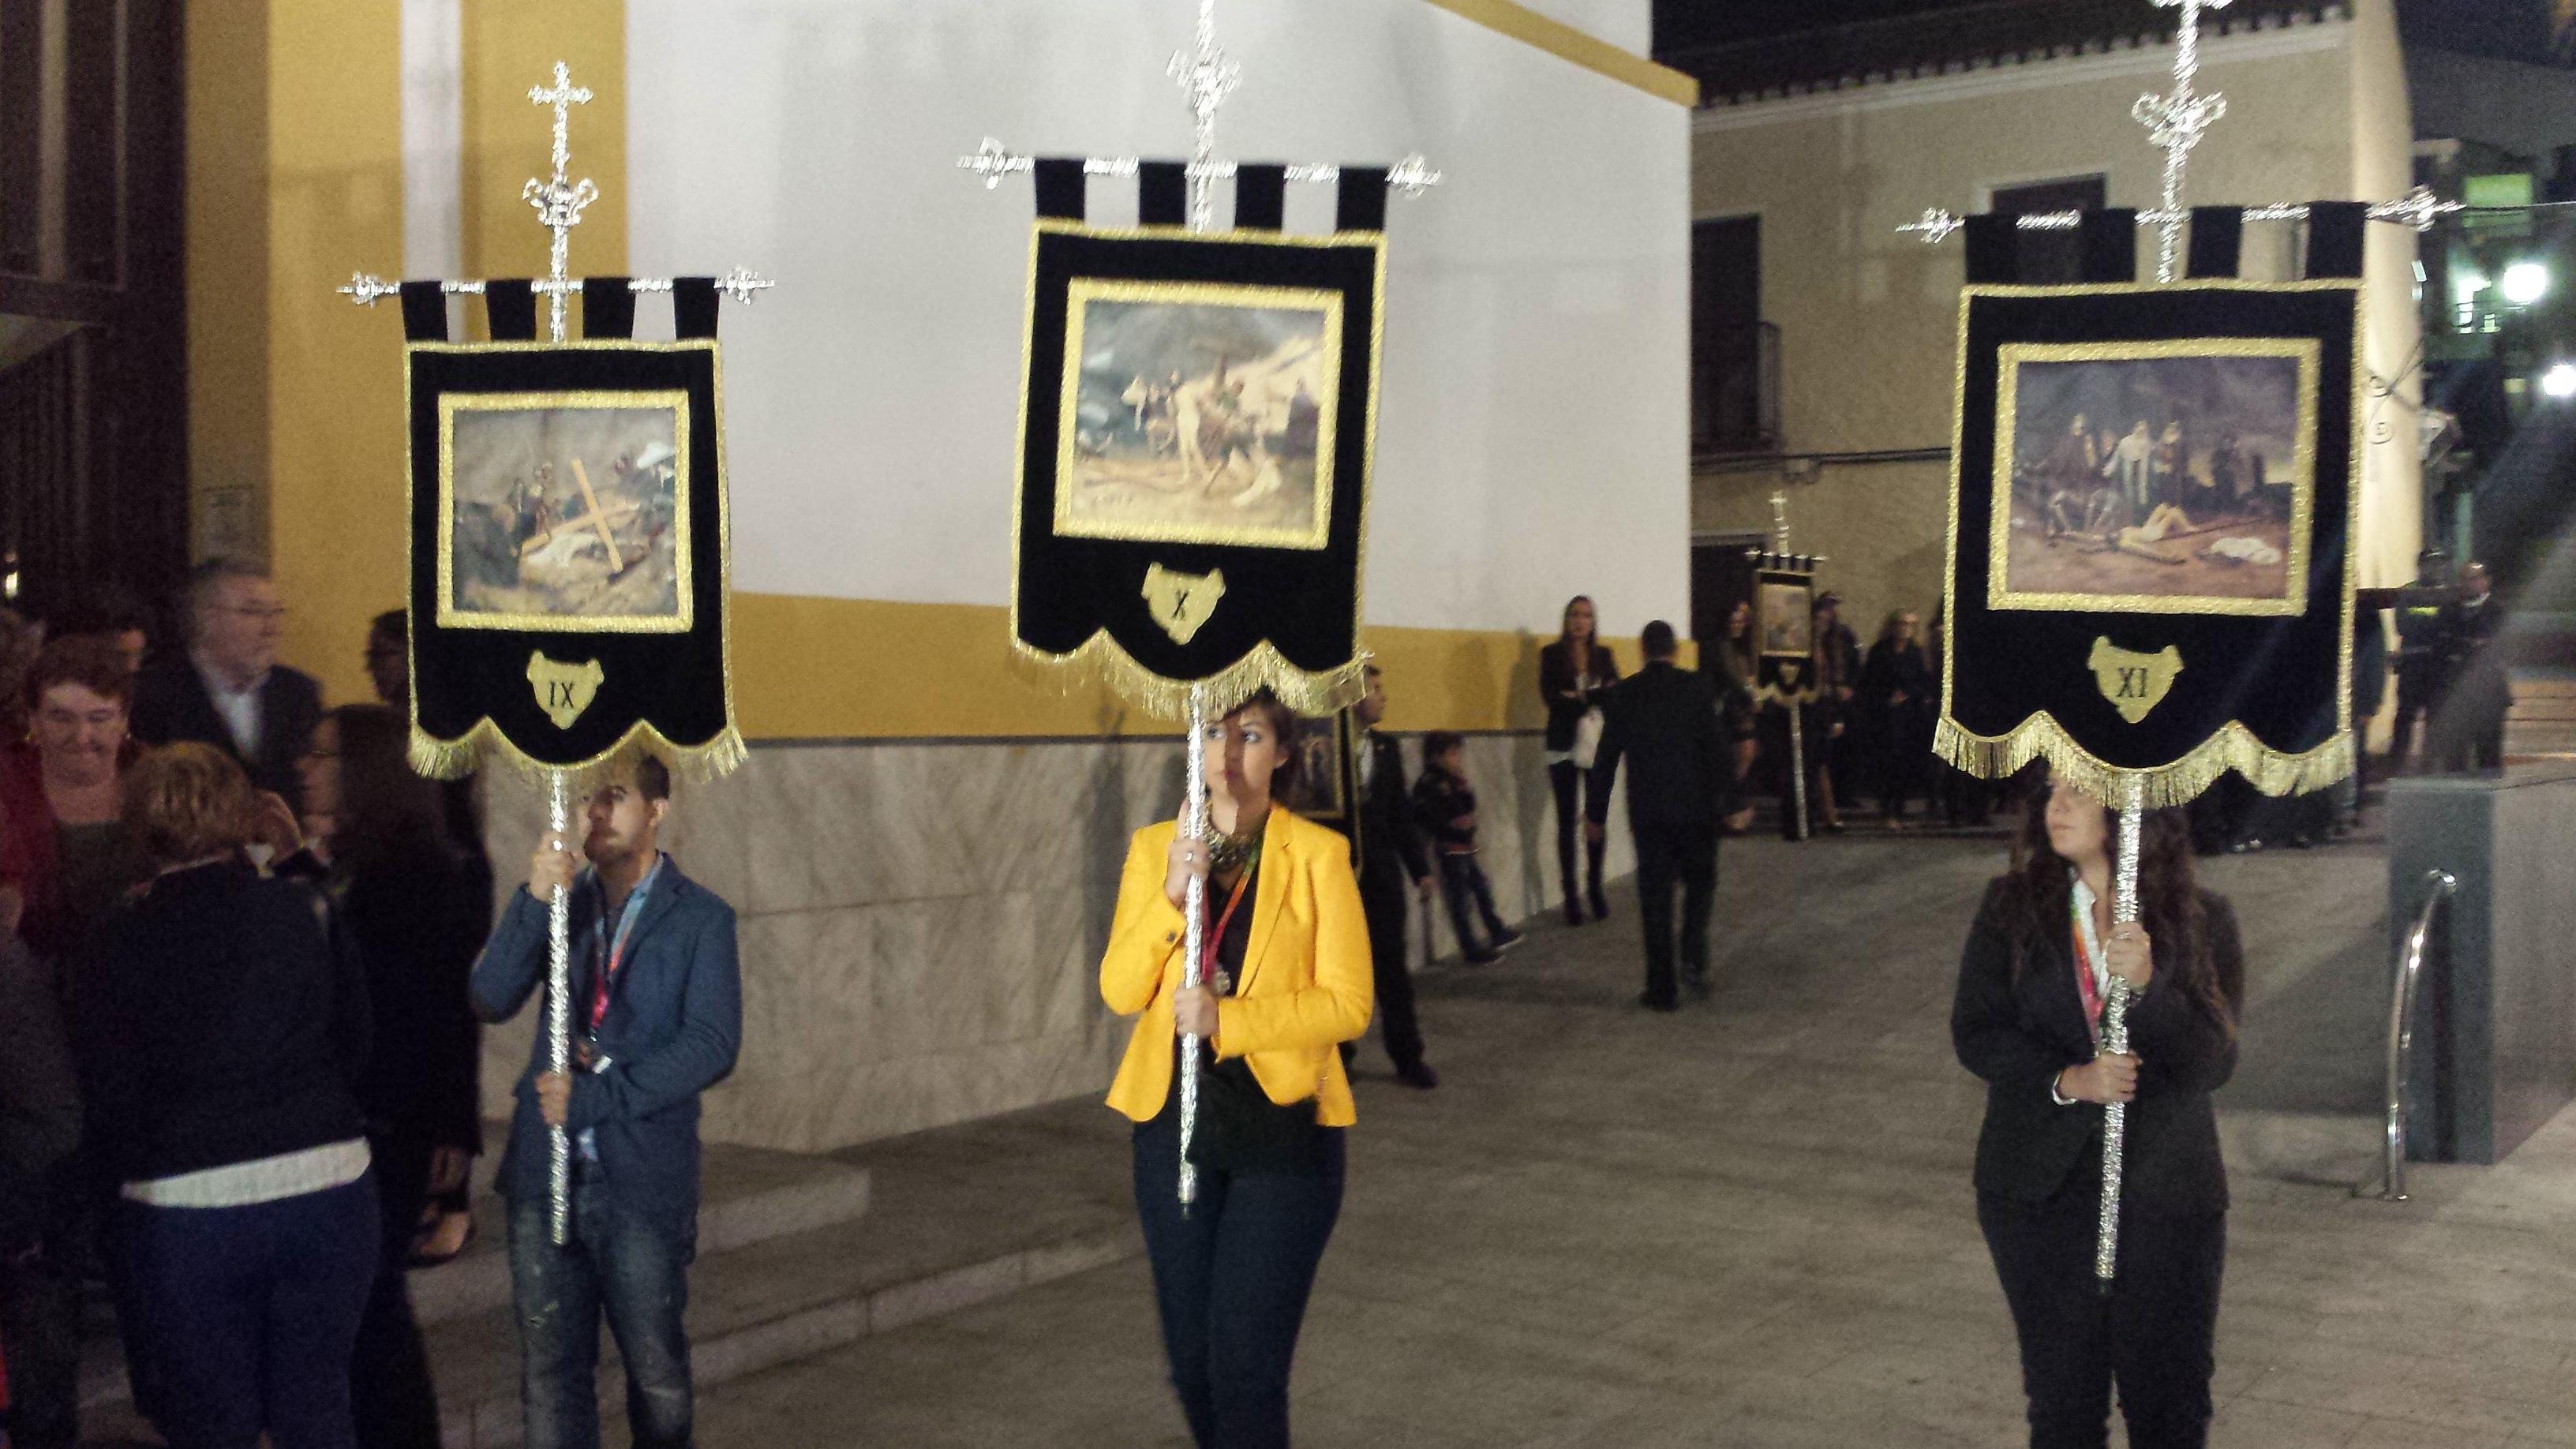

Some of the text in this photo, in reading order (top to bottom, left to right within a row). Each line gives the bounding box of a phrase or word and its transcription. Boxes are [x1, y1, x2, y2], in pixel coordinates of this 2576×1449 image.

[1170, 590, 1189, 620] X
[549, 681, 575, 708] IX
[2116, 667, 2147, 698] XI
